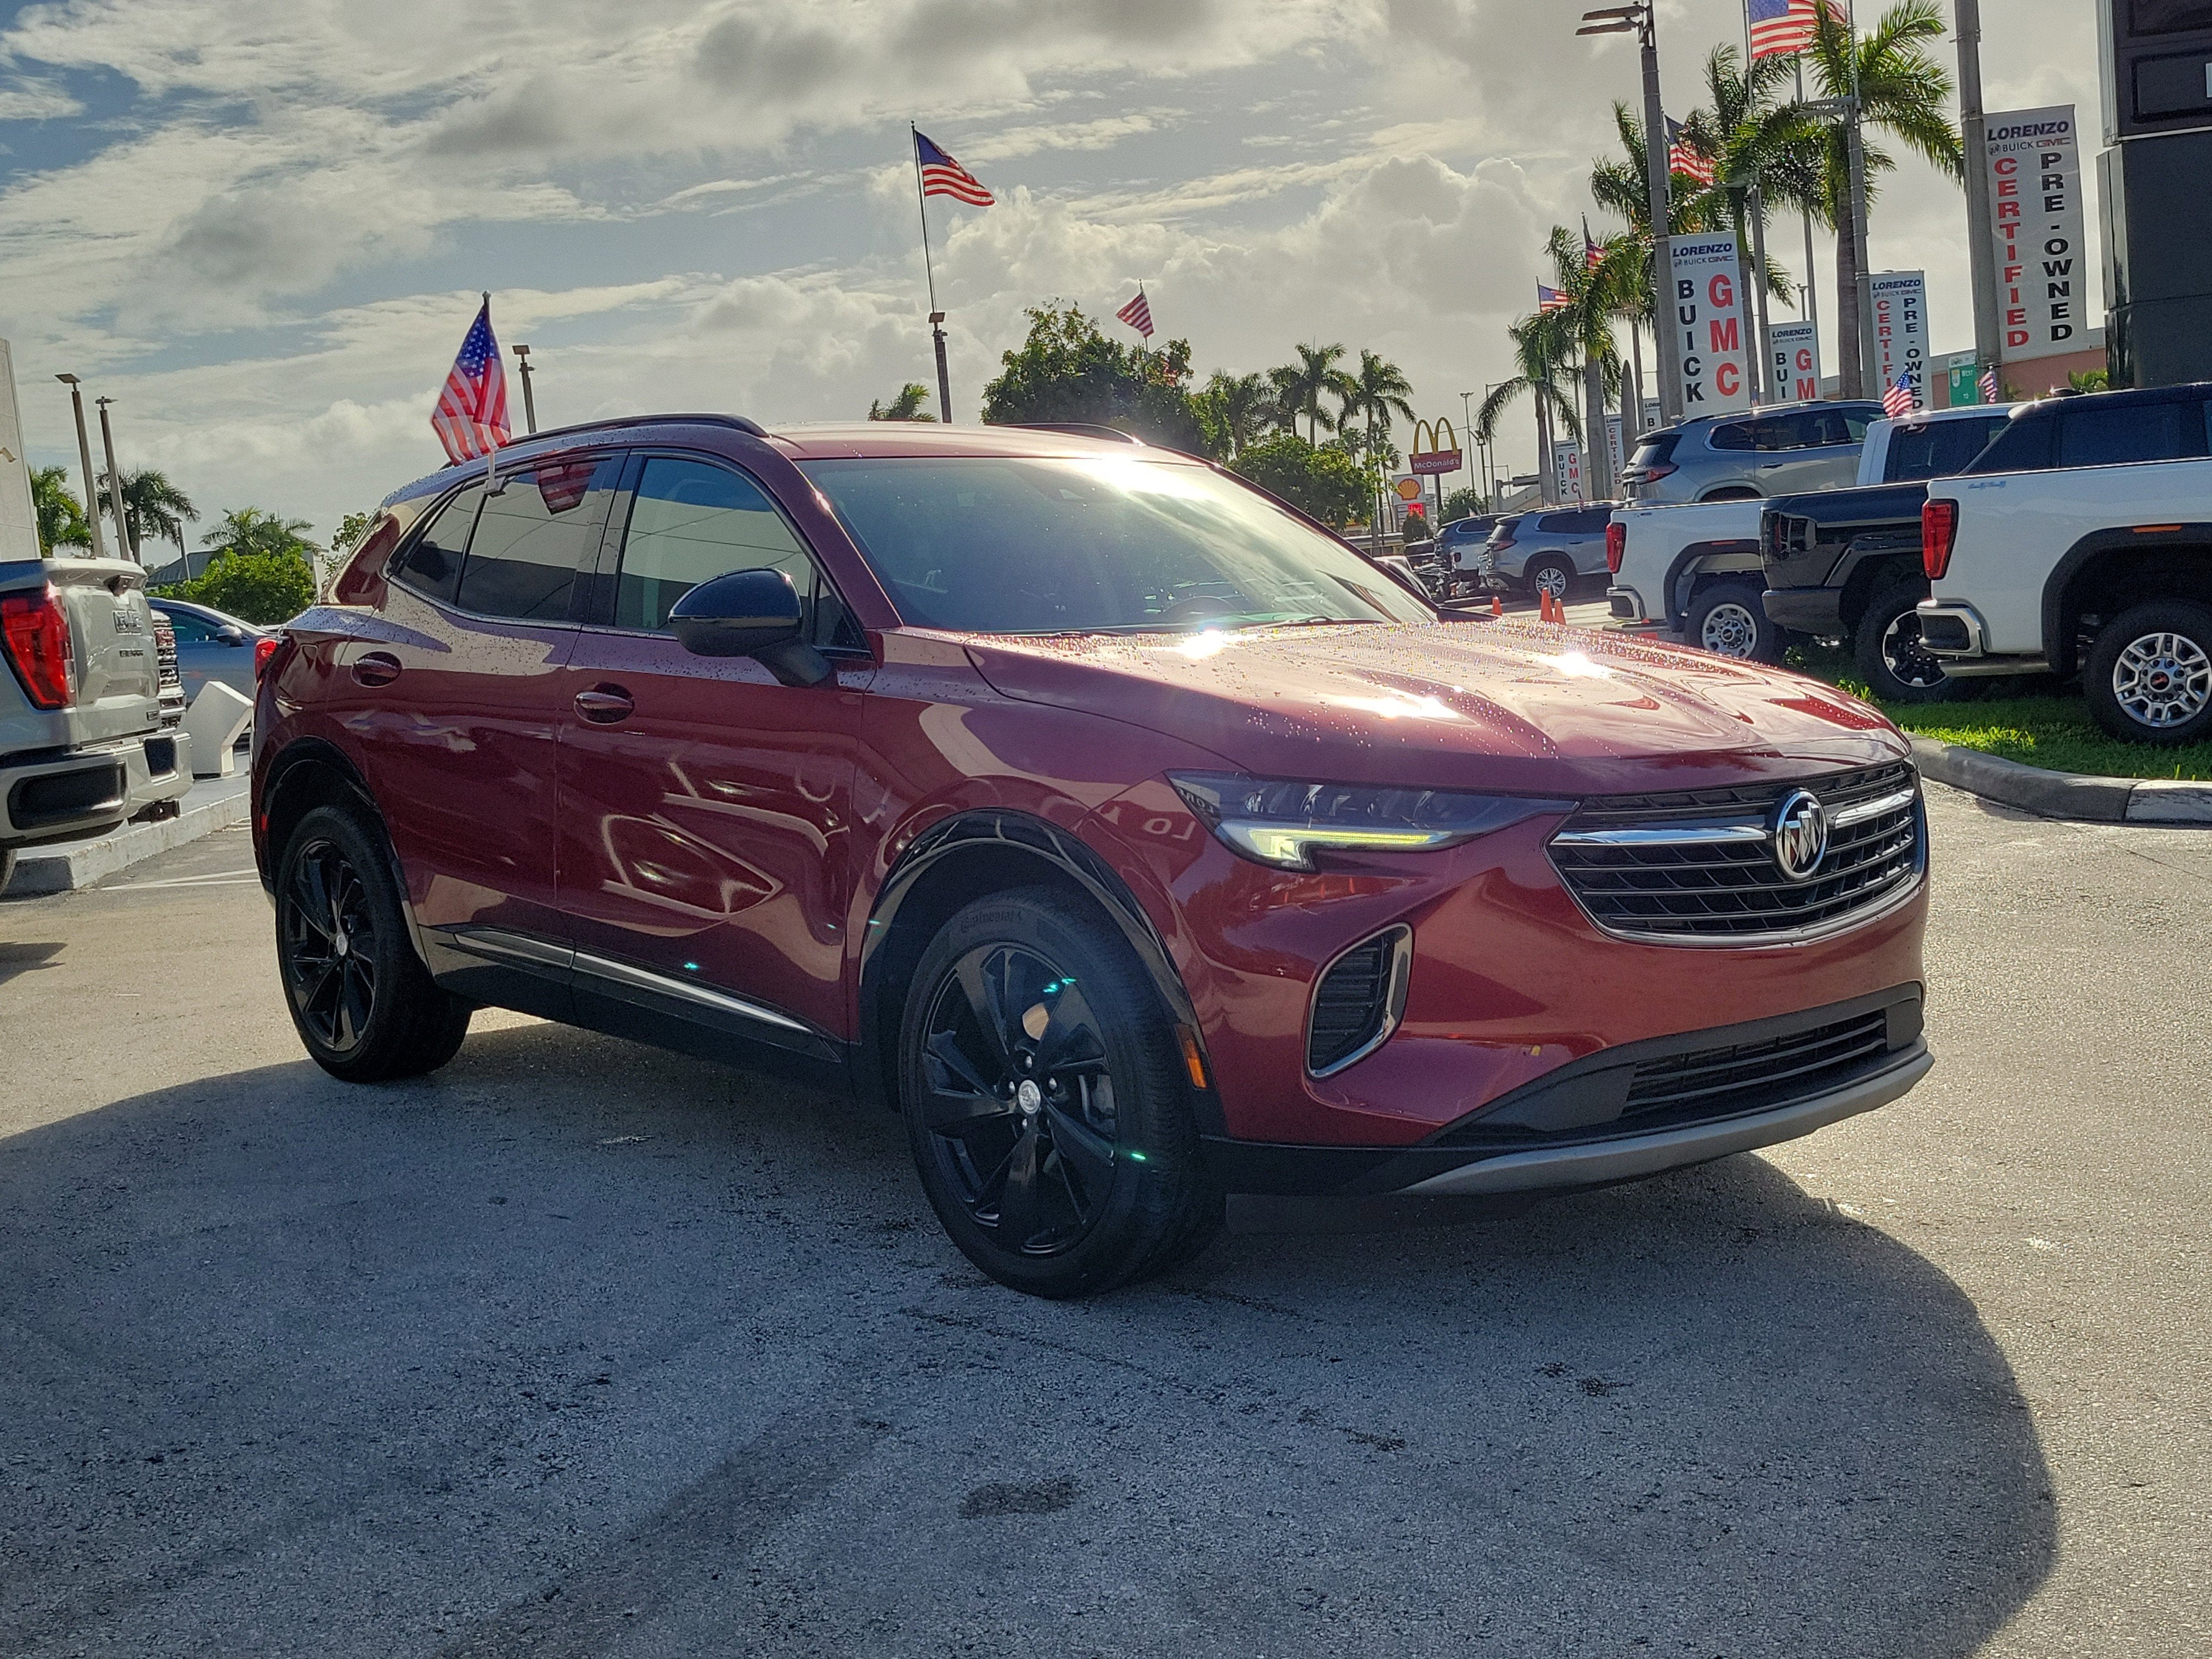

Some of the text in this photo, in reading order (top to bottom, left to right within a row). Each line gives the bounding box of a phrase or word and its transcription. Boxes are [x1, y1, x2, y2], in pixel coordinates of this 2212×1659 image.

[1987, 121, 2069, 142] LORENZO
[2003, 138, 2070, 152] BUICK GMC
[1672, 243, 1733, 257] LORENZO
[1684, 257, 1707, 266] BUICK
[1994, 157, 2029, 347] CERTIFIED
[1872, 279, 1921, 290] LORENZO
[1678, 280, 1705, 402] BUICK
[1708, 274, 1740, 396] GMC
[1772, 328, 1812, 337] LORENZO
[1877, 301, 1893, 394] CERTIFI
[1775, 353, 1788, 398] BUI
[1796, 349, 1816, 400] GM
[1414, 459, 1459, 469] McDonald's
[1559, 455, 1567, 495] BUICK
[1568, 453, 1579, 493] GMC
[1609, 428, 1621, 484] CERTIFIED
